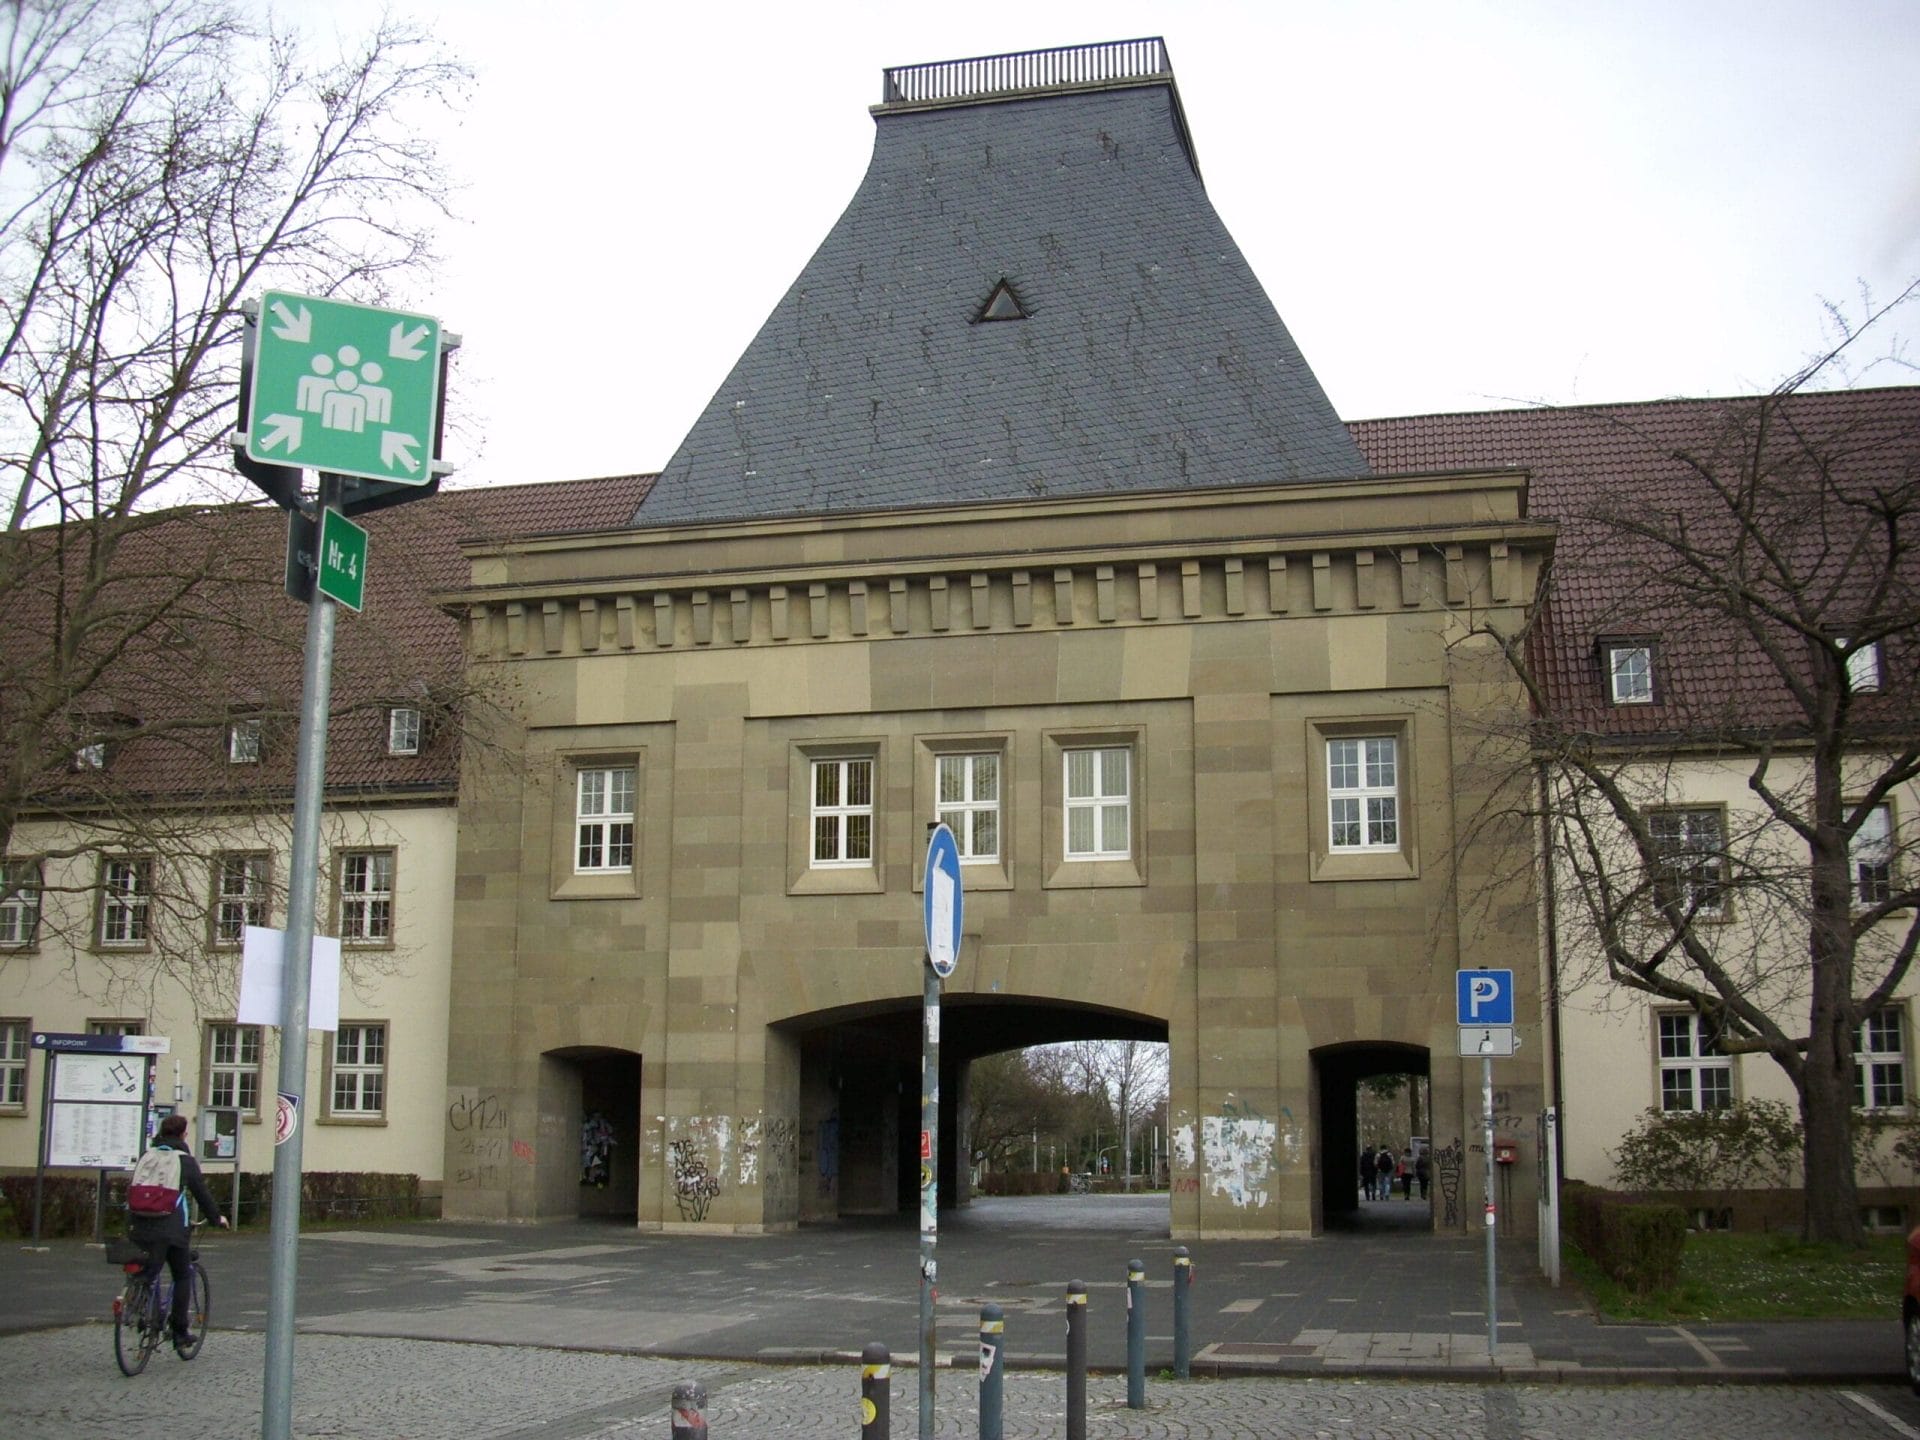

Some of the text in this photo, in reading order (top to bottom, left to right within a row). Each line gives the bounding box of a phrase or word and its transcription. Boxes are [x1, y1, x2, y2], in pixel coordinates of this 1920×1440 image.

[328, 539, 357, 580] Nr. 4
[1471, 977, 1499, 1018] P
[52, 1039, 88, 1047] INFOPOINT
